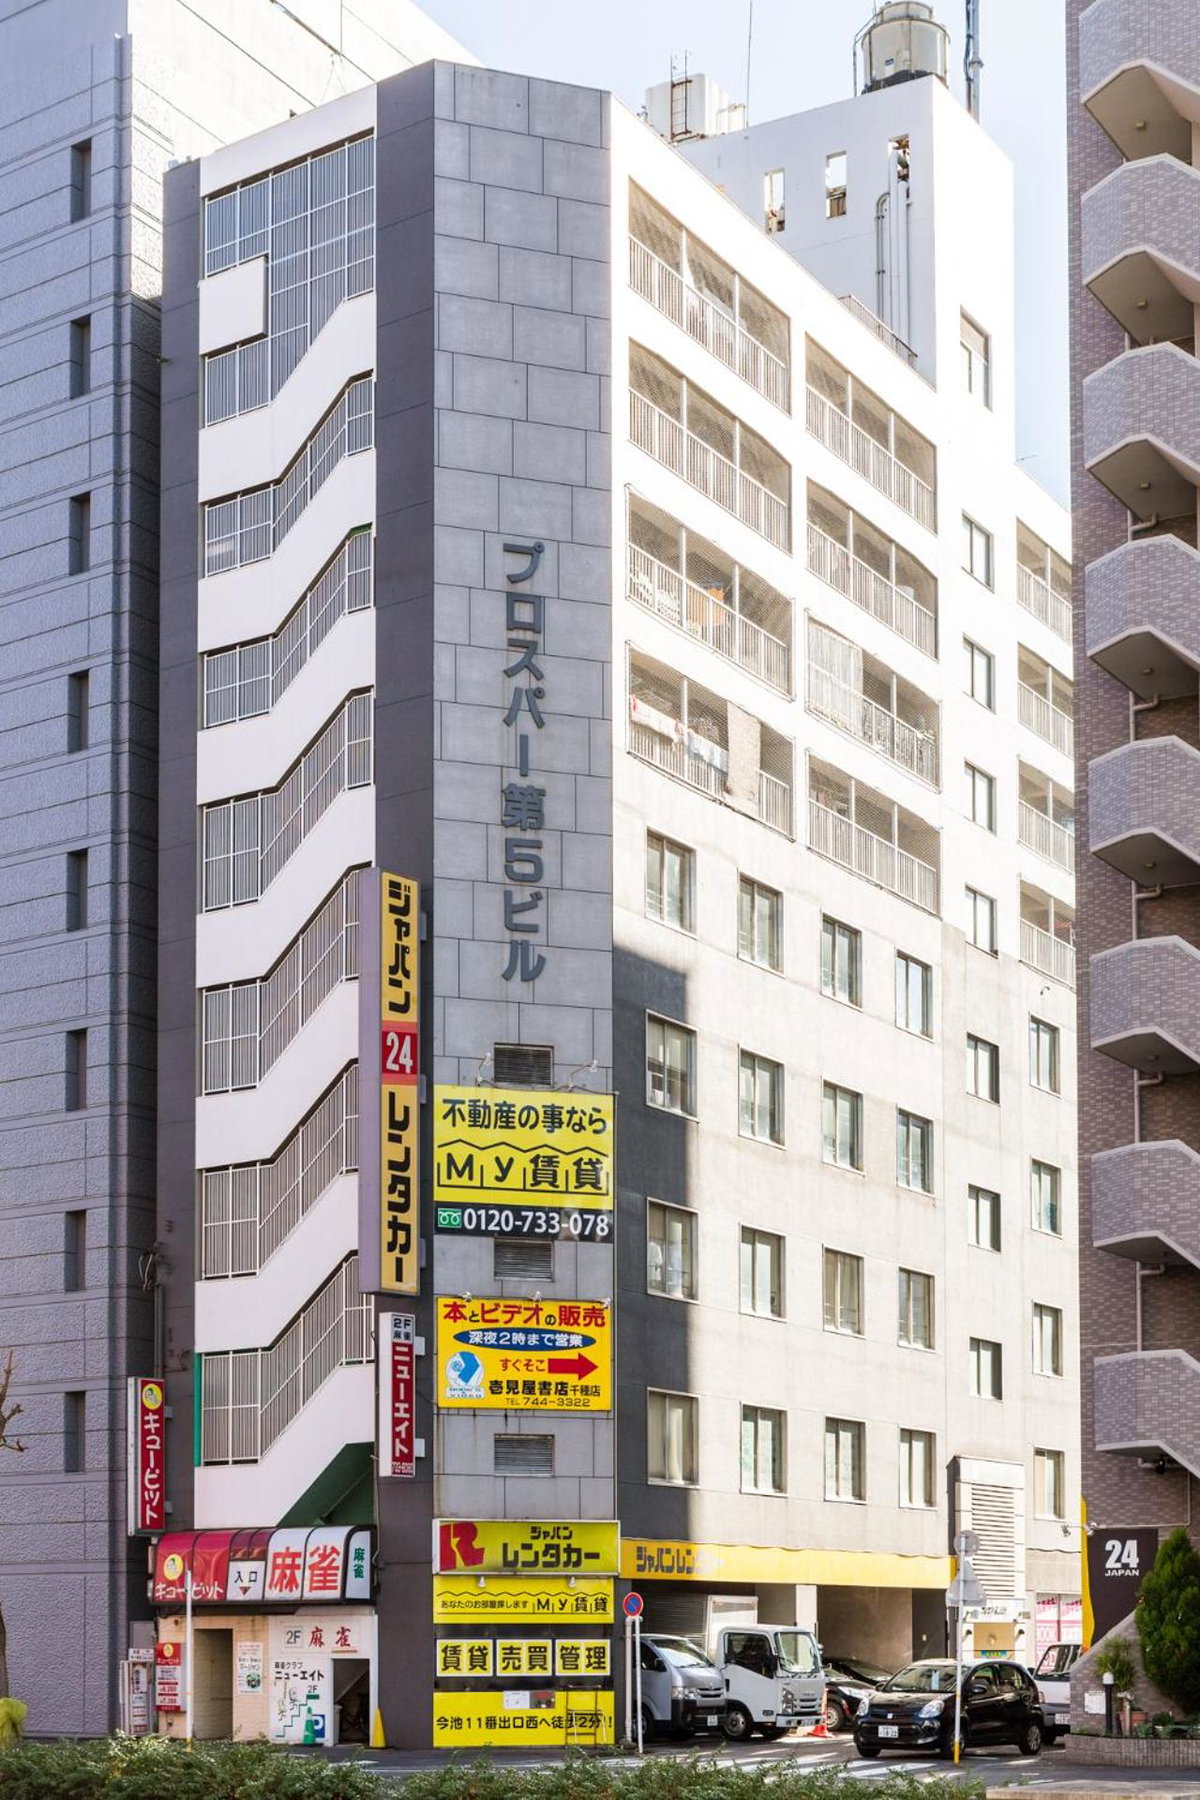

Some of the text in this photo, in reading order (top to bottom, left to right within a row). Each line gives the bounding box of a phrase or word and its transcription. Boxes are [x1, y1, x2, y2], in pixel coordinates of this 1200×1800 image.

[503, 541, 546, 982] プロスパー第5ビル
[388, 880, 411, 1014] ジャパン
[386, 1032, 413, 1074] 24
[442, 1098, 608, 1135] 不動産の事なら
[387, 1091, 412, 1283] レンタカー
[463, 1208, 609, 1236] 0120-733-078
[393, 1318, 412, 1329] 2F
[443, 1301, 606, 1328] 本とビデオの販売
[468, 1331, 584, 1347] 深夜2時まで営業
[500, 1358, 547, 1373] すぐそこ
[394, 1346, 411, 1457] ニューエイト
[506, 1397, 591, 1408] TEL 744-3322
[530, 1526, 573, 1541] ジャパン
[353, 1548, 365, 1579] 麻雀
[502, 1542, 600, 1569] レンタカー
[1105, 1540, 1139, 1568] 24
[234, 1571, 258, 1584] 入口
[268, 1546, 341, 1593] 麻雀
[1105, 1569, 1140, 1577] JAPAN
[441, 1600, 529, 1610] あなたのお部屋探します
[286, 1626, 352, 1648] 2F 麻雀
[441, 1645, 607, 1672] 賃貸 売買 管理
[274, 1670, 325, 1681] ニューエイト
[307, 1685, 318, 1694] 2F
